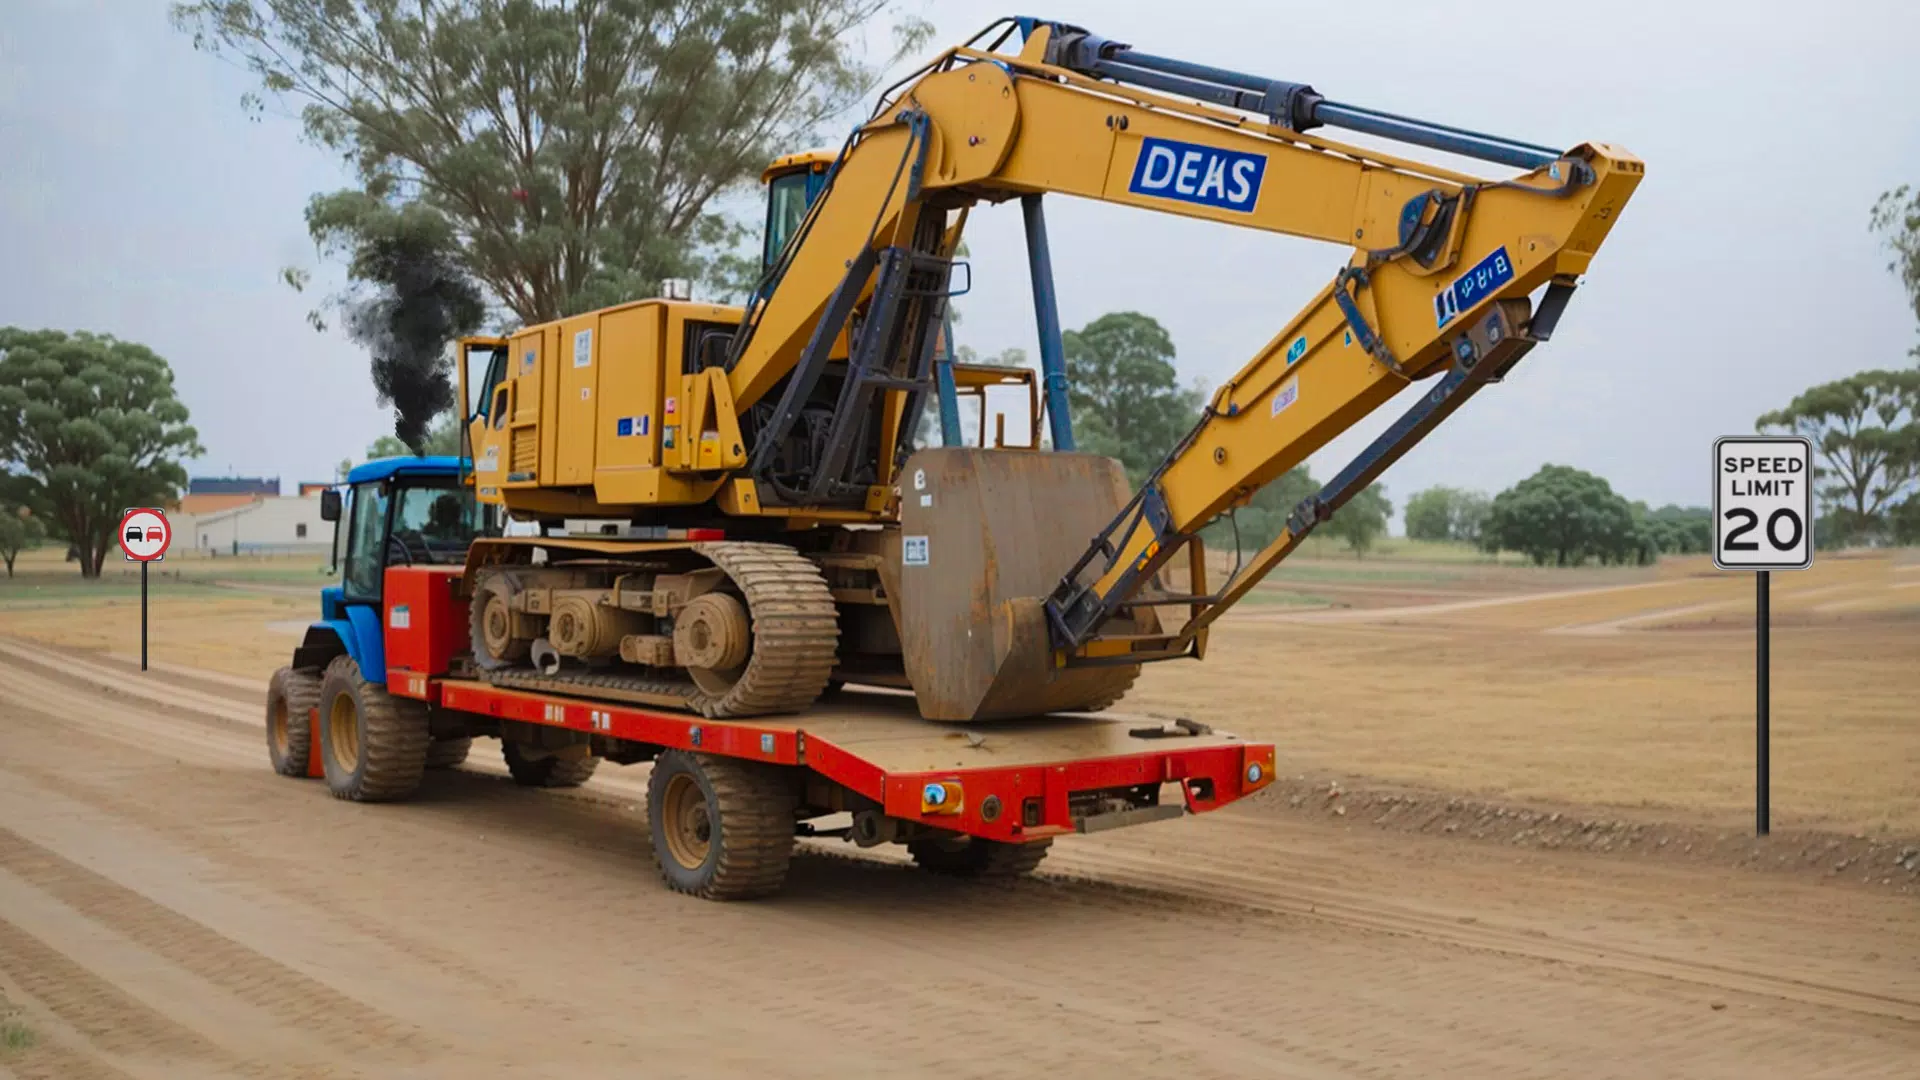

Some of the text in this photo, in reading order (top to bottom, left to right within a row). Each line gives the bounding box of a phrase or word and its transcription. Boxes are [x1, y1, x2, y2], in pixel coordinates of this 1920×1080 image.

[1141, 145, 1255, 203] DEAS
[1724, 457, 1803, 473] SPEED
[1732, 480, 1794, 496] LIMIT
[1724, 507, 1803, 551] 20
